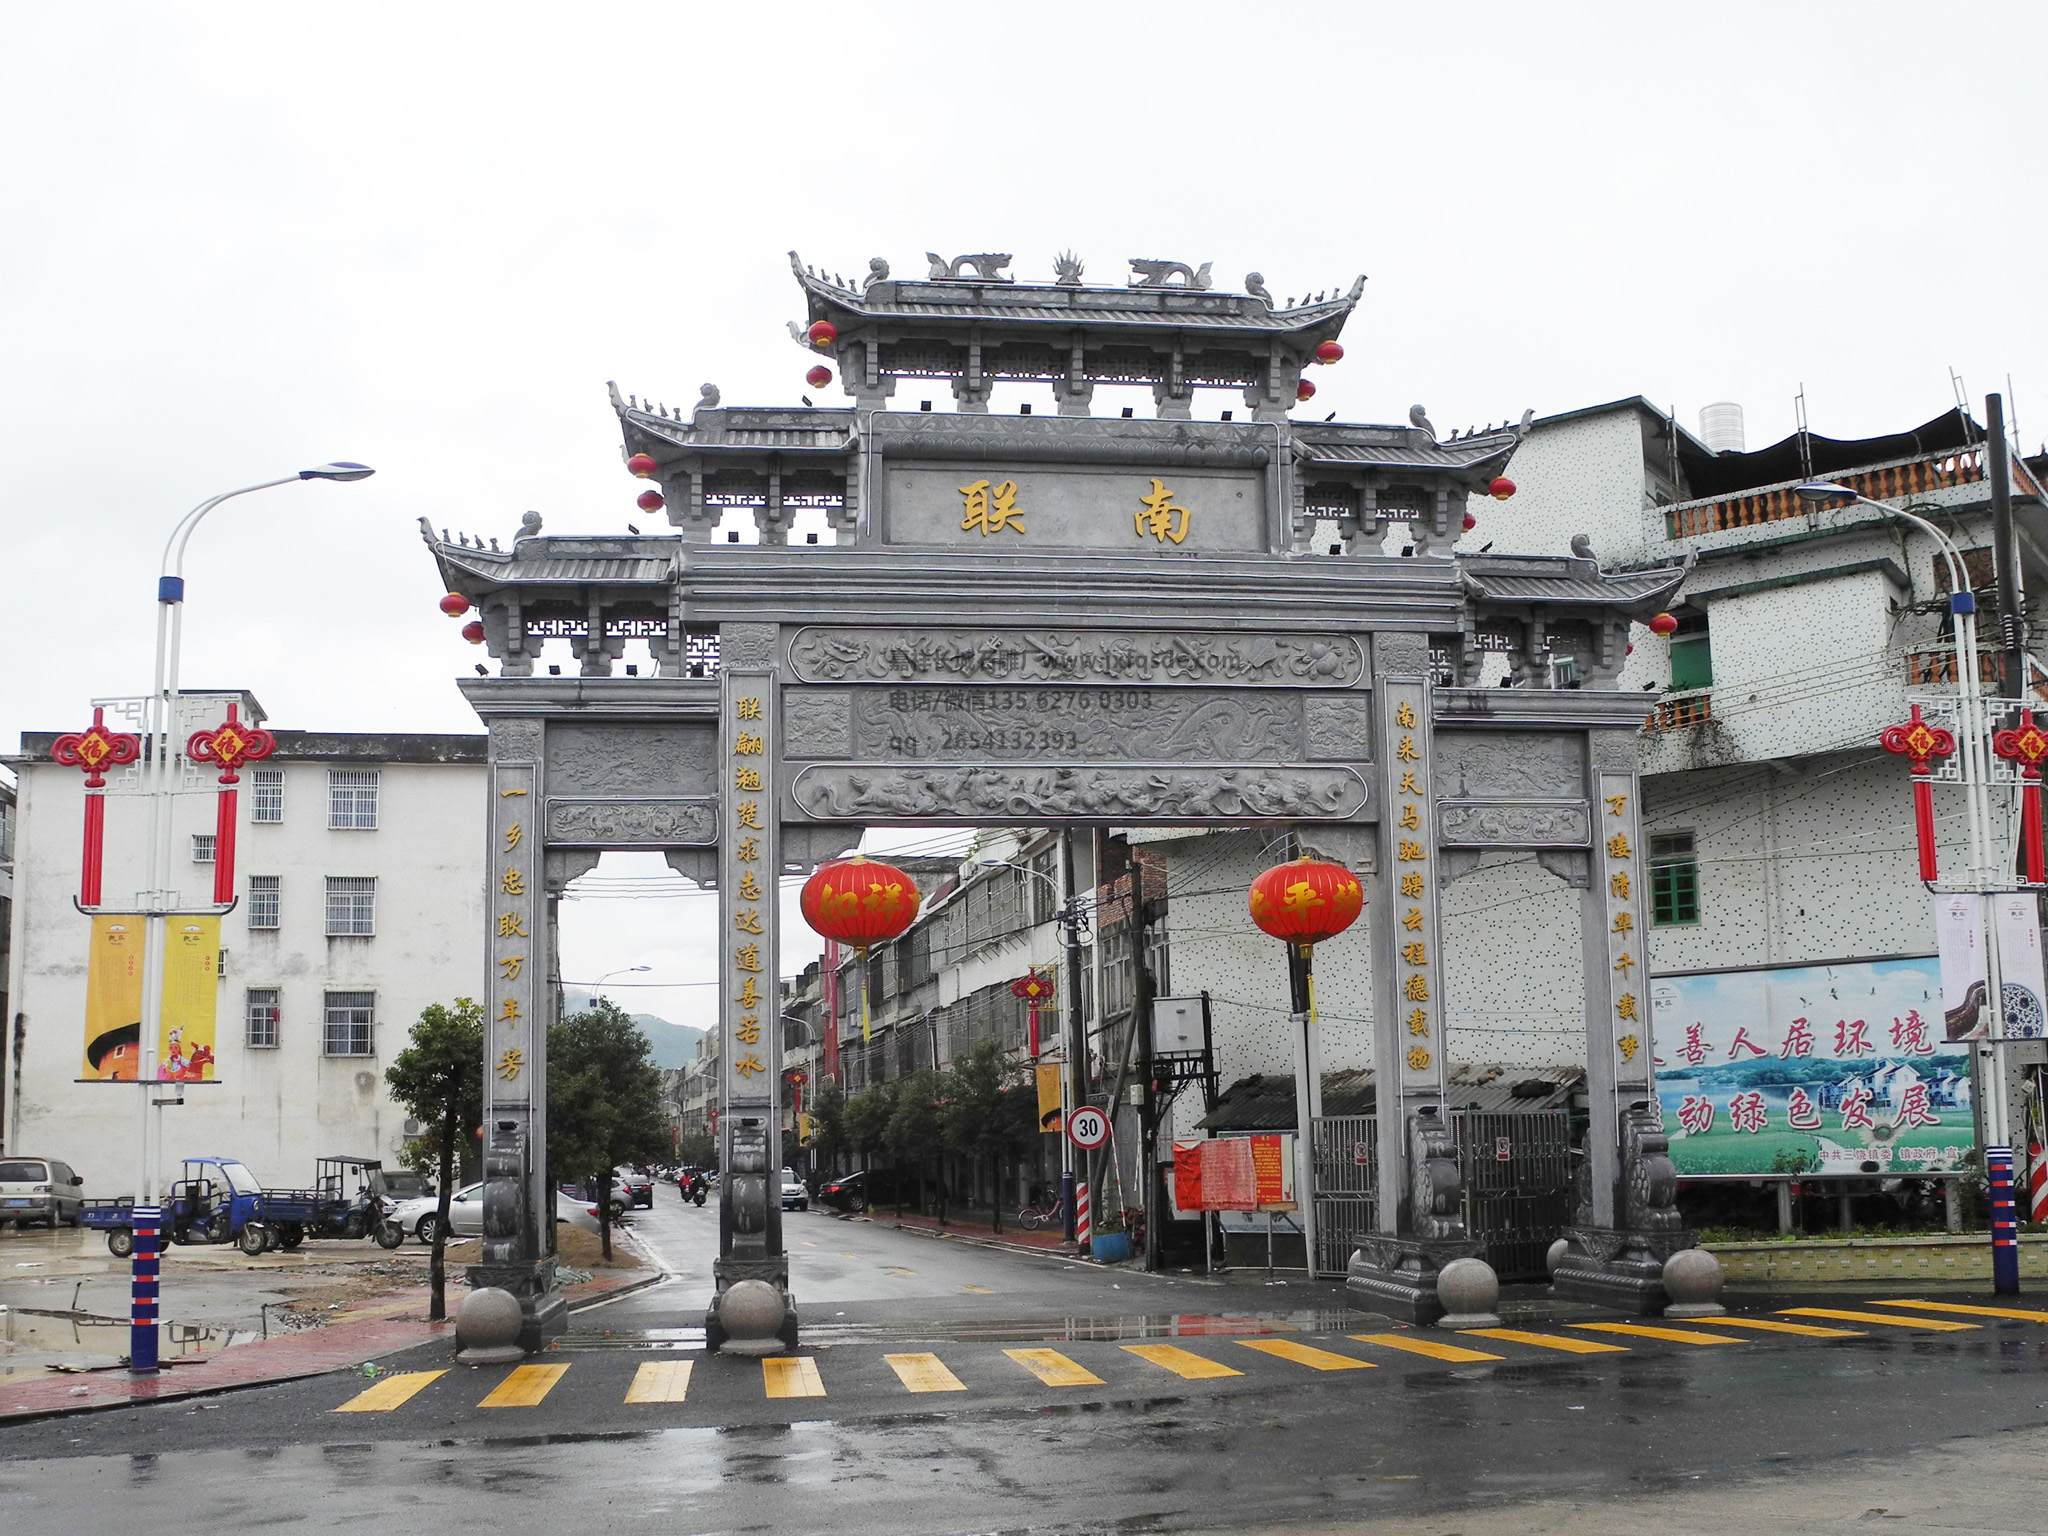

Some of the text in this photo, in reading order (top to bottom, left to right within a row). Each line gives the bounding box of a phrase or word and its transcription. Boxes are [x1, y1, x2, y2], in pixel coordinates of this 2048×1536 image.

[496, 789, 528, 1081] 一乡忠耿万年芳
[1656, 1010, 1933, 1064] 善人居环境
[1079, 1118, 1098, 1137] 30
[1657, 1084, 1938, 1132] 动绿色发展
